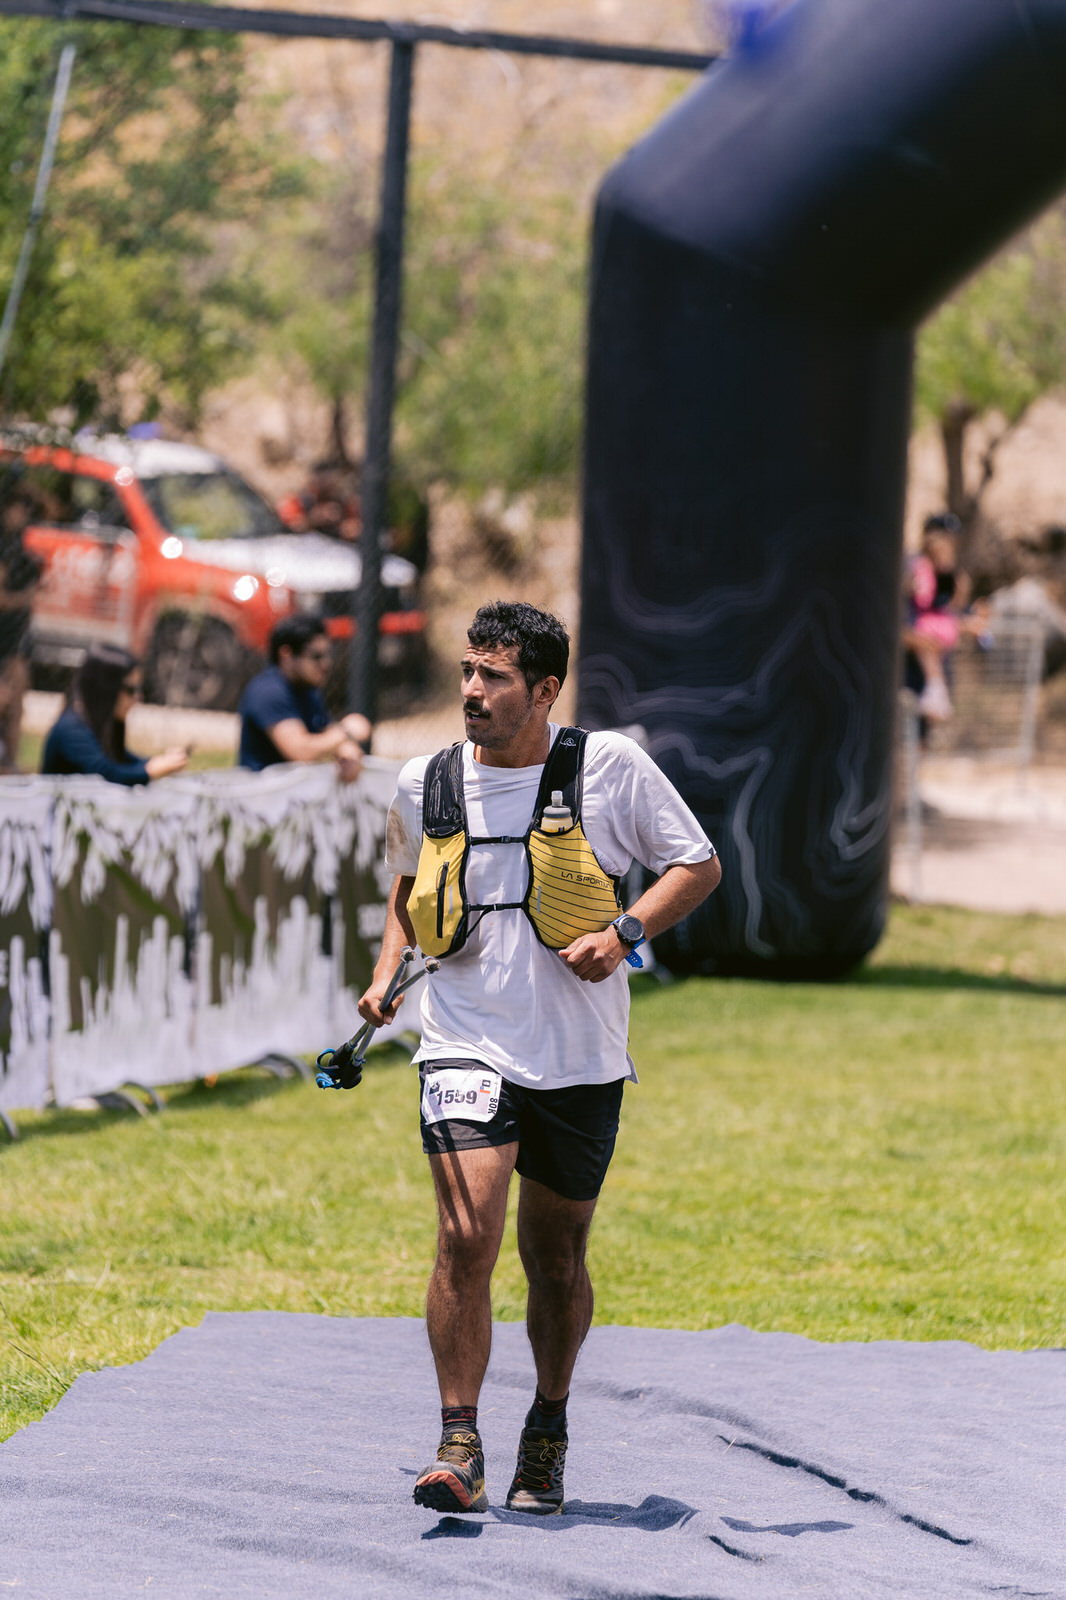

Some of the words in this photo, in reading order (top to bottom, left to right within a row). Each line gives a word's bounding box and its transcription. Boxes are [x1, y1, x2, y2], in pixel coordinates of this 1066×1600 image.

[561, 871, 573, 880] LA
[437, 1089, 477, 1106] 1559
[487, 1097, 498, 1115] 80K
